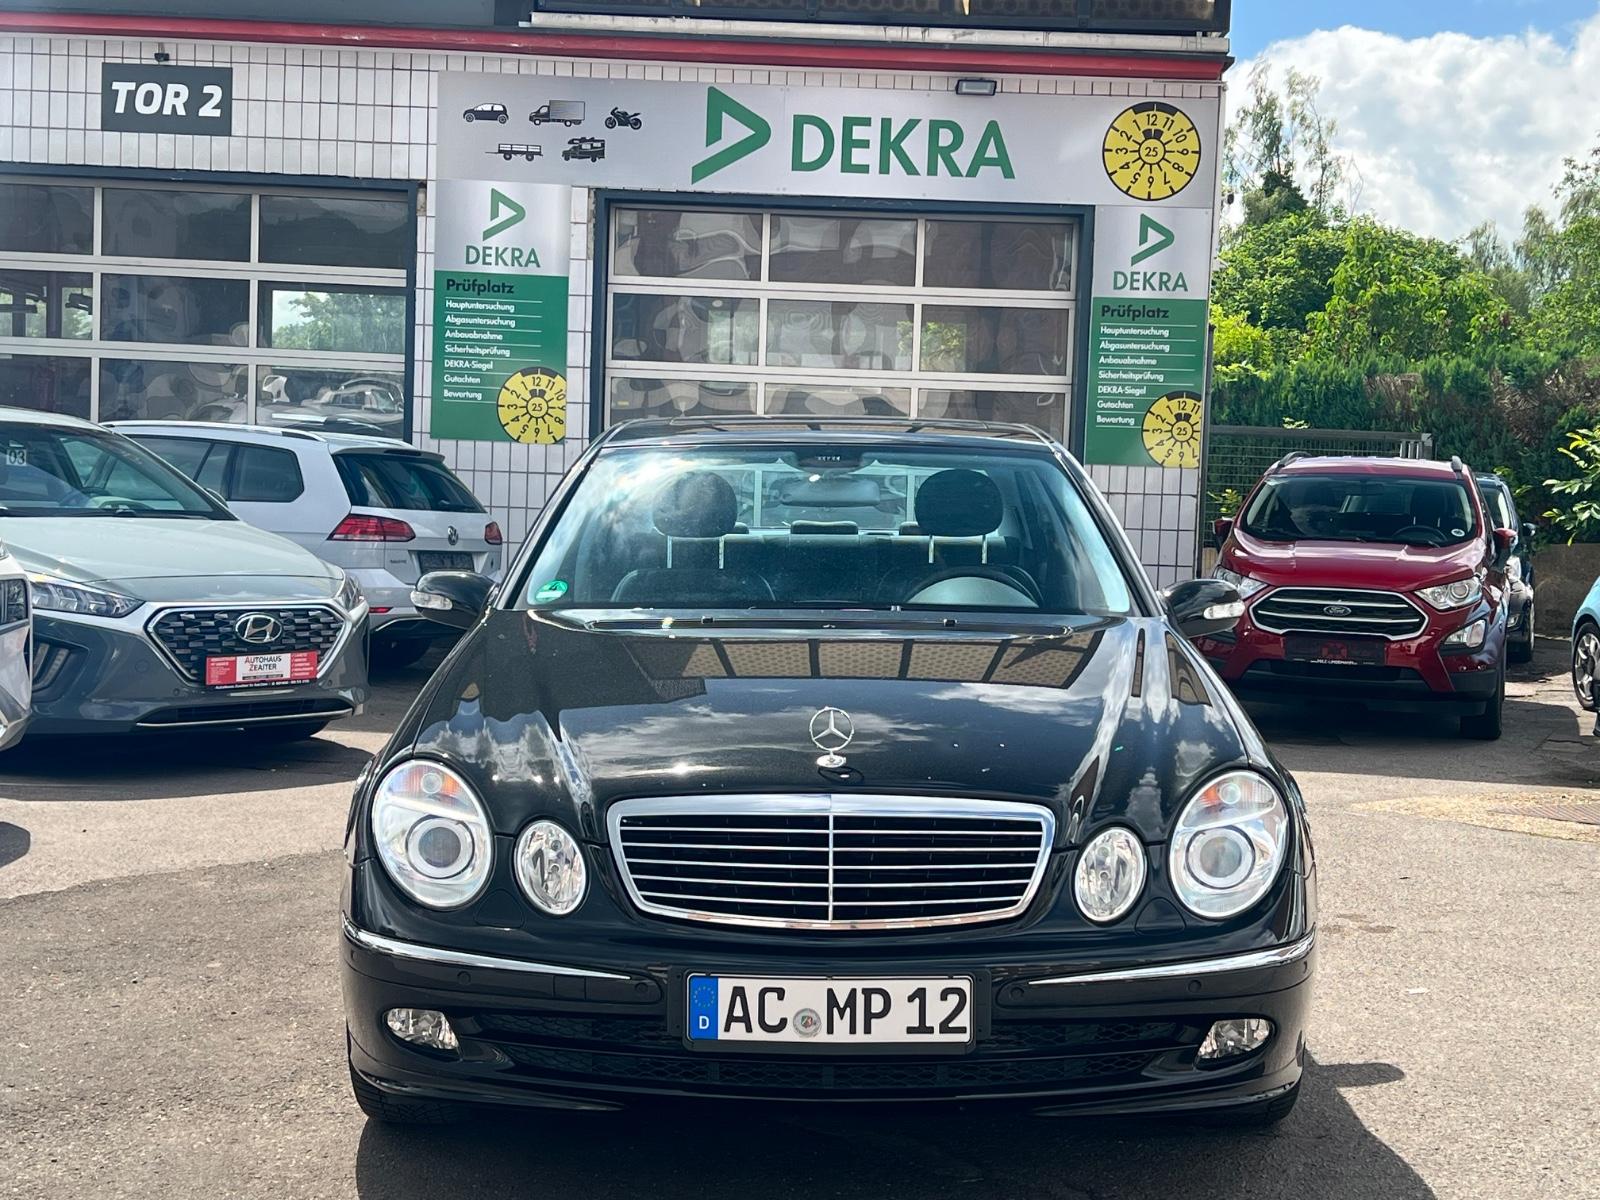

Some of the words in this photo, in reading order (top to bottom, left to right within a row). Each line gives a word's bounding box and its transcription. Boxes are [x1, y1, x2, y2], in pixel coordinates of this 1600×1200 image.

[111, 82, 190, 116] TOR
[198, 84, 222, 118] 2
[1132, 119, 1141, 131] 1
[1146, 114, 1158, 126] 12
[1162, 117, 1175, 131] 11
[1120, 130, 1132, 142] 2
[1173, 128, 1187, 143] 10
[791, 114, 1016, 179] DEKRA
[1144, 147, 1158, 157] 25
[1119, 162, 1130, 170] 4
[1172, 162, 1184, 172] 8
[1130, 172, 1141, 184] 5
[1147, 176, 1154, 189] 6
[1163, 171, 1171, 185] 7
[465, 245, 541, 268] DEKRA
[1112, 270, 1188, 292] DEKRA
[446, 278, 514, 296] Prüfplatz
[445, 300, 515, 313] Hauptuntersuchung
[1101, 304, 1170, 321] Prüfplatz
[445, 315, 516, 328] Abgasuntersuchung
[445, 330, 503, 340] Anbauabnahme
[1100, 326, 1170, 337] Hauptuntersuchung
[444, 345, 511, 357] Sicherheitsprüfung
[1100, 341, 1170, 352] Abgasuntersuchung
[444, 360, 493, 371] DEKRA-Siegel
[1099, 356, 1157, 365] Anbauabnahme
[444, 374, 480, 384] Gutachten
[532, 376, 542, 387] 12
[1098, 371, 1164, 382] Sicherheitsprüfung
[521, 381, 528, 390] 1
[545, 379, 555, 391] 11
[444, 389, 482, 400] Bewertung
[510, 391, 521, 399] 2
[554, 389, 566, 401] 10
[1098, 386, 1146, 396] DEKRA-Siegel
[532, 403, 542, 412] 25
[1097, 400, 1134, 409] Gutachten
[1166, 405, 1174, 415] 1
[1177, 400, 1187, 410] 12
[1191, 403, 1200, 415] 11
[554, 416, 564, 425] 8
[1096, 415, 1135, 425] Bewertung
[1155, 414, 1166, 424] 2
[520, 424, 529, 434] 5
[534, 427, 540, 437] 6
[547, 424, 553, 435] 7
[1176, 427, 1188, 436] 25
[1165, 448, 1174, 458] 5
[1178, 451, 1184, 461] 6
[1192, 447, 1198, 458] 7
[245, 656, 282, 664] AUTOHAUS
[724, 986, 788, 1034] AC
[826, 987, 892, 1035] MP
[906, 987, 968, 1035] 12
[699, 1016, 710, 1030] D
